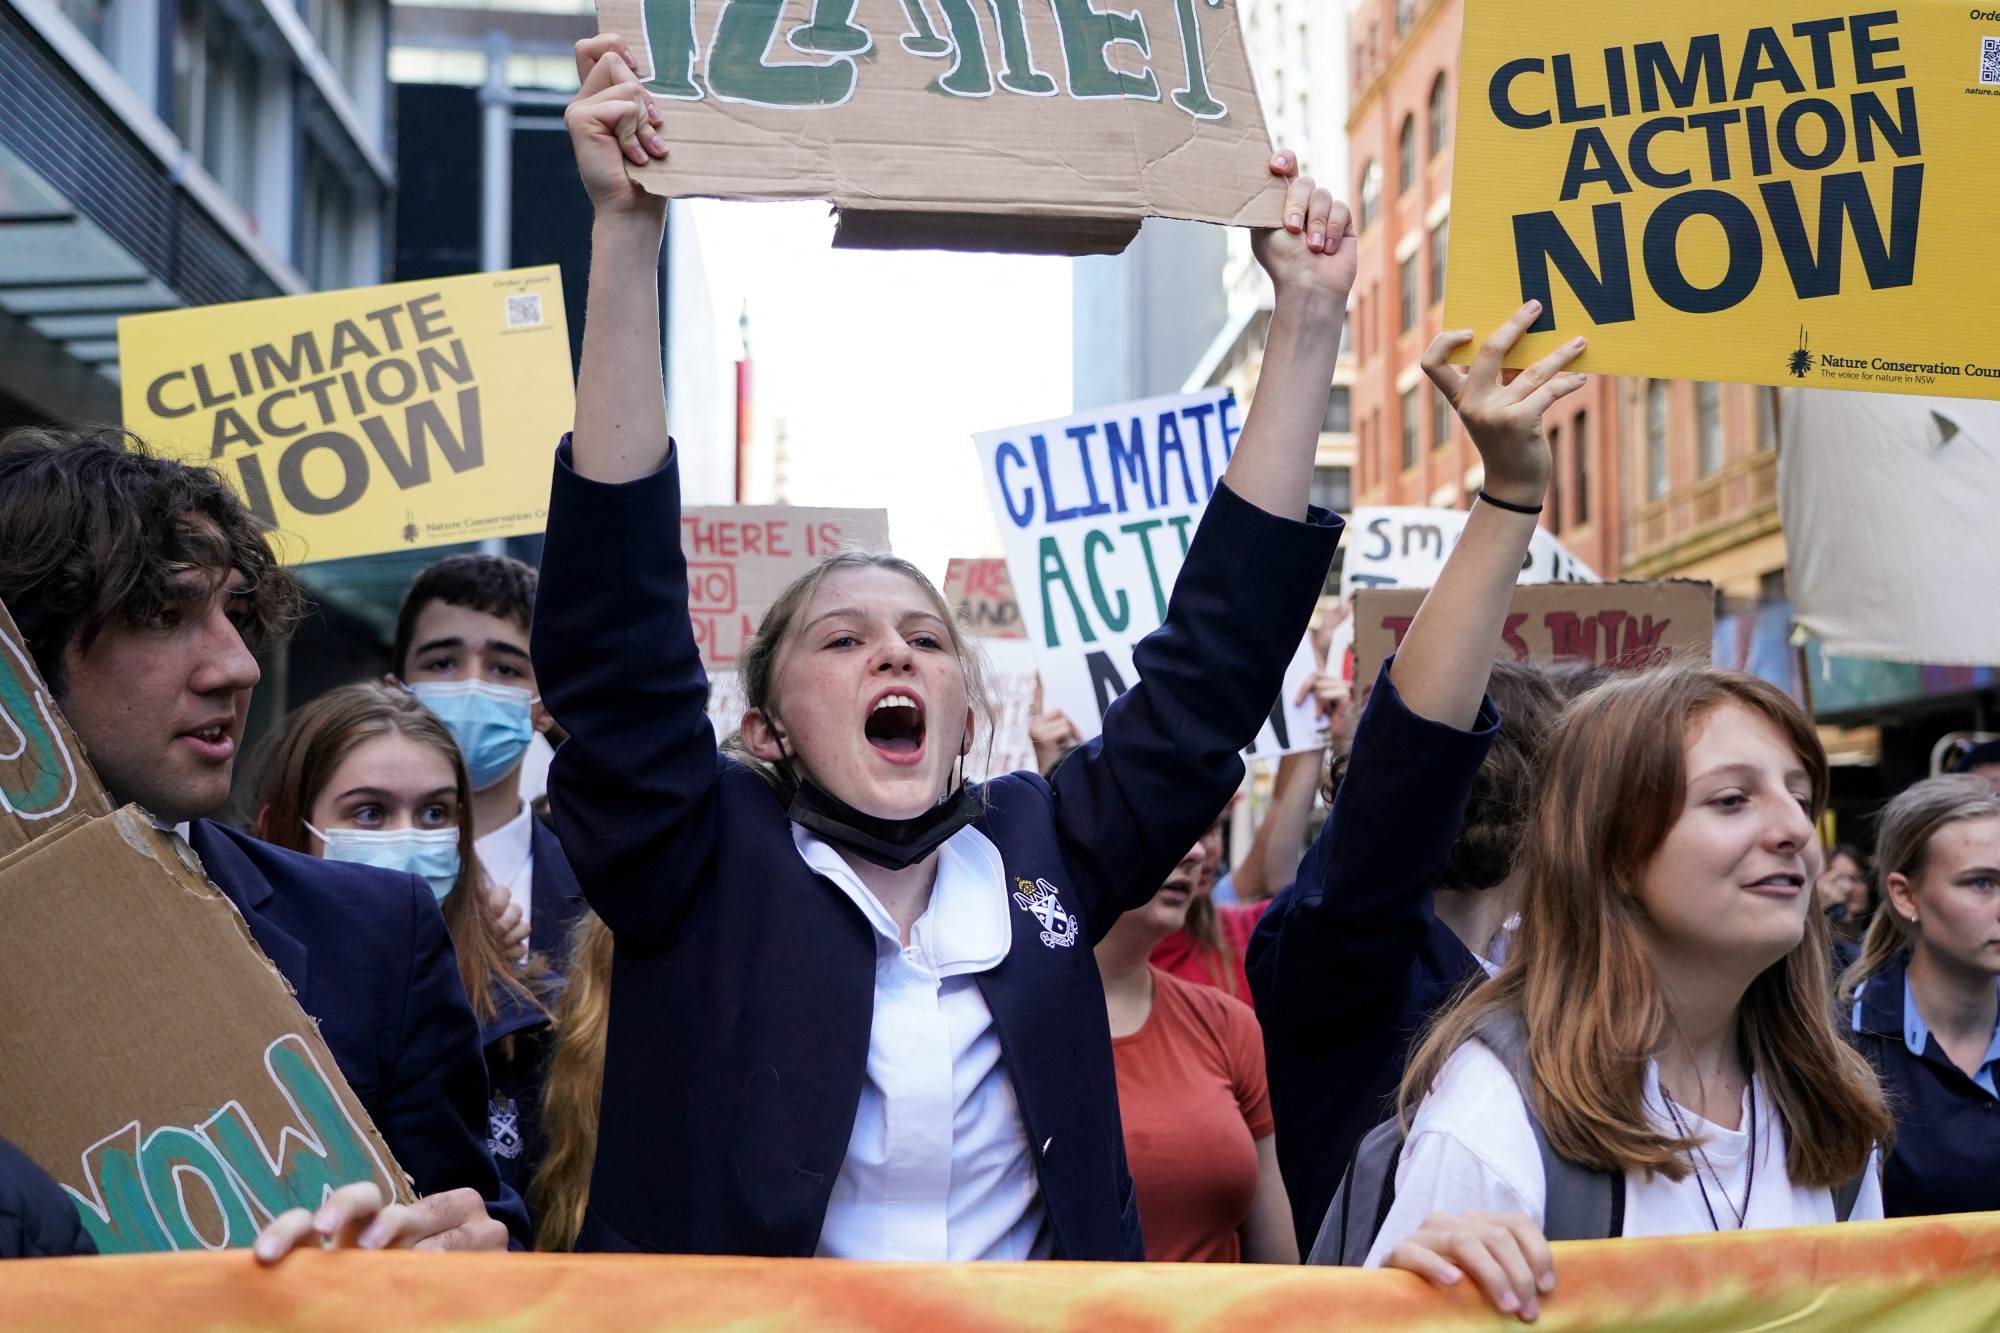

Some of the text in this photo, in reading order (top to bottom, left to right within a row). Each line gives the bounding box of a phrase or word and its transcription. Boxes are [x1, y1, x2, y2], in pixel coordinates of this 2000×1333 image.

[1969, 9, 2000, 22] Orde
[1488, 9, 1906, 130] CLIMATE
[1558, 86, 1922, 202] ACTION
[1511, 162, 1925, 334] NOW
[146, 292, 454, 419] CLIMATE
[1821, 354, 2000, 379] Nature Conservation Coun
[1821, 369, 1937, 384] The voice for nature in NSW
[210, 338, 475, 459] ACTION
[681, 517, 844, 557] THERE IS
[956, 600, 1019, 626] AND
